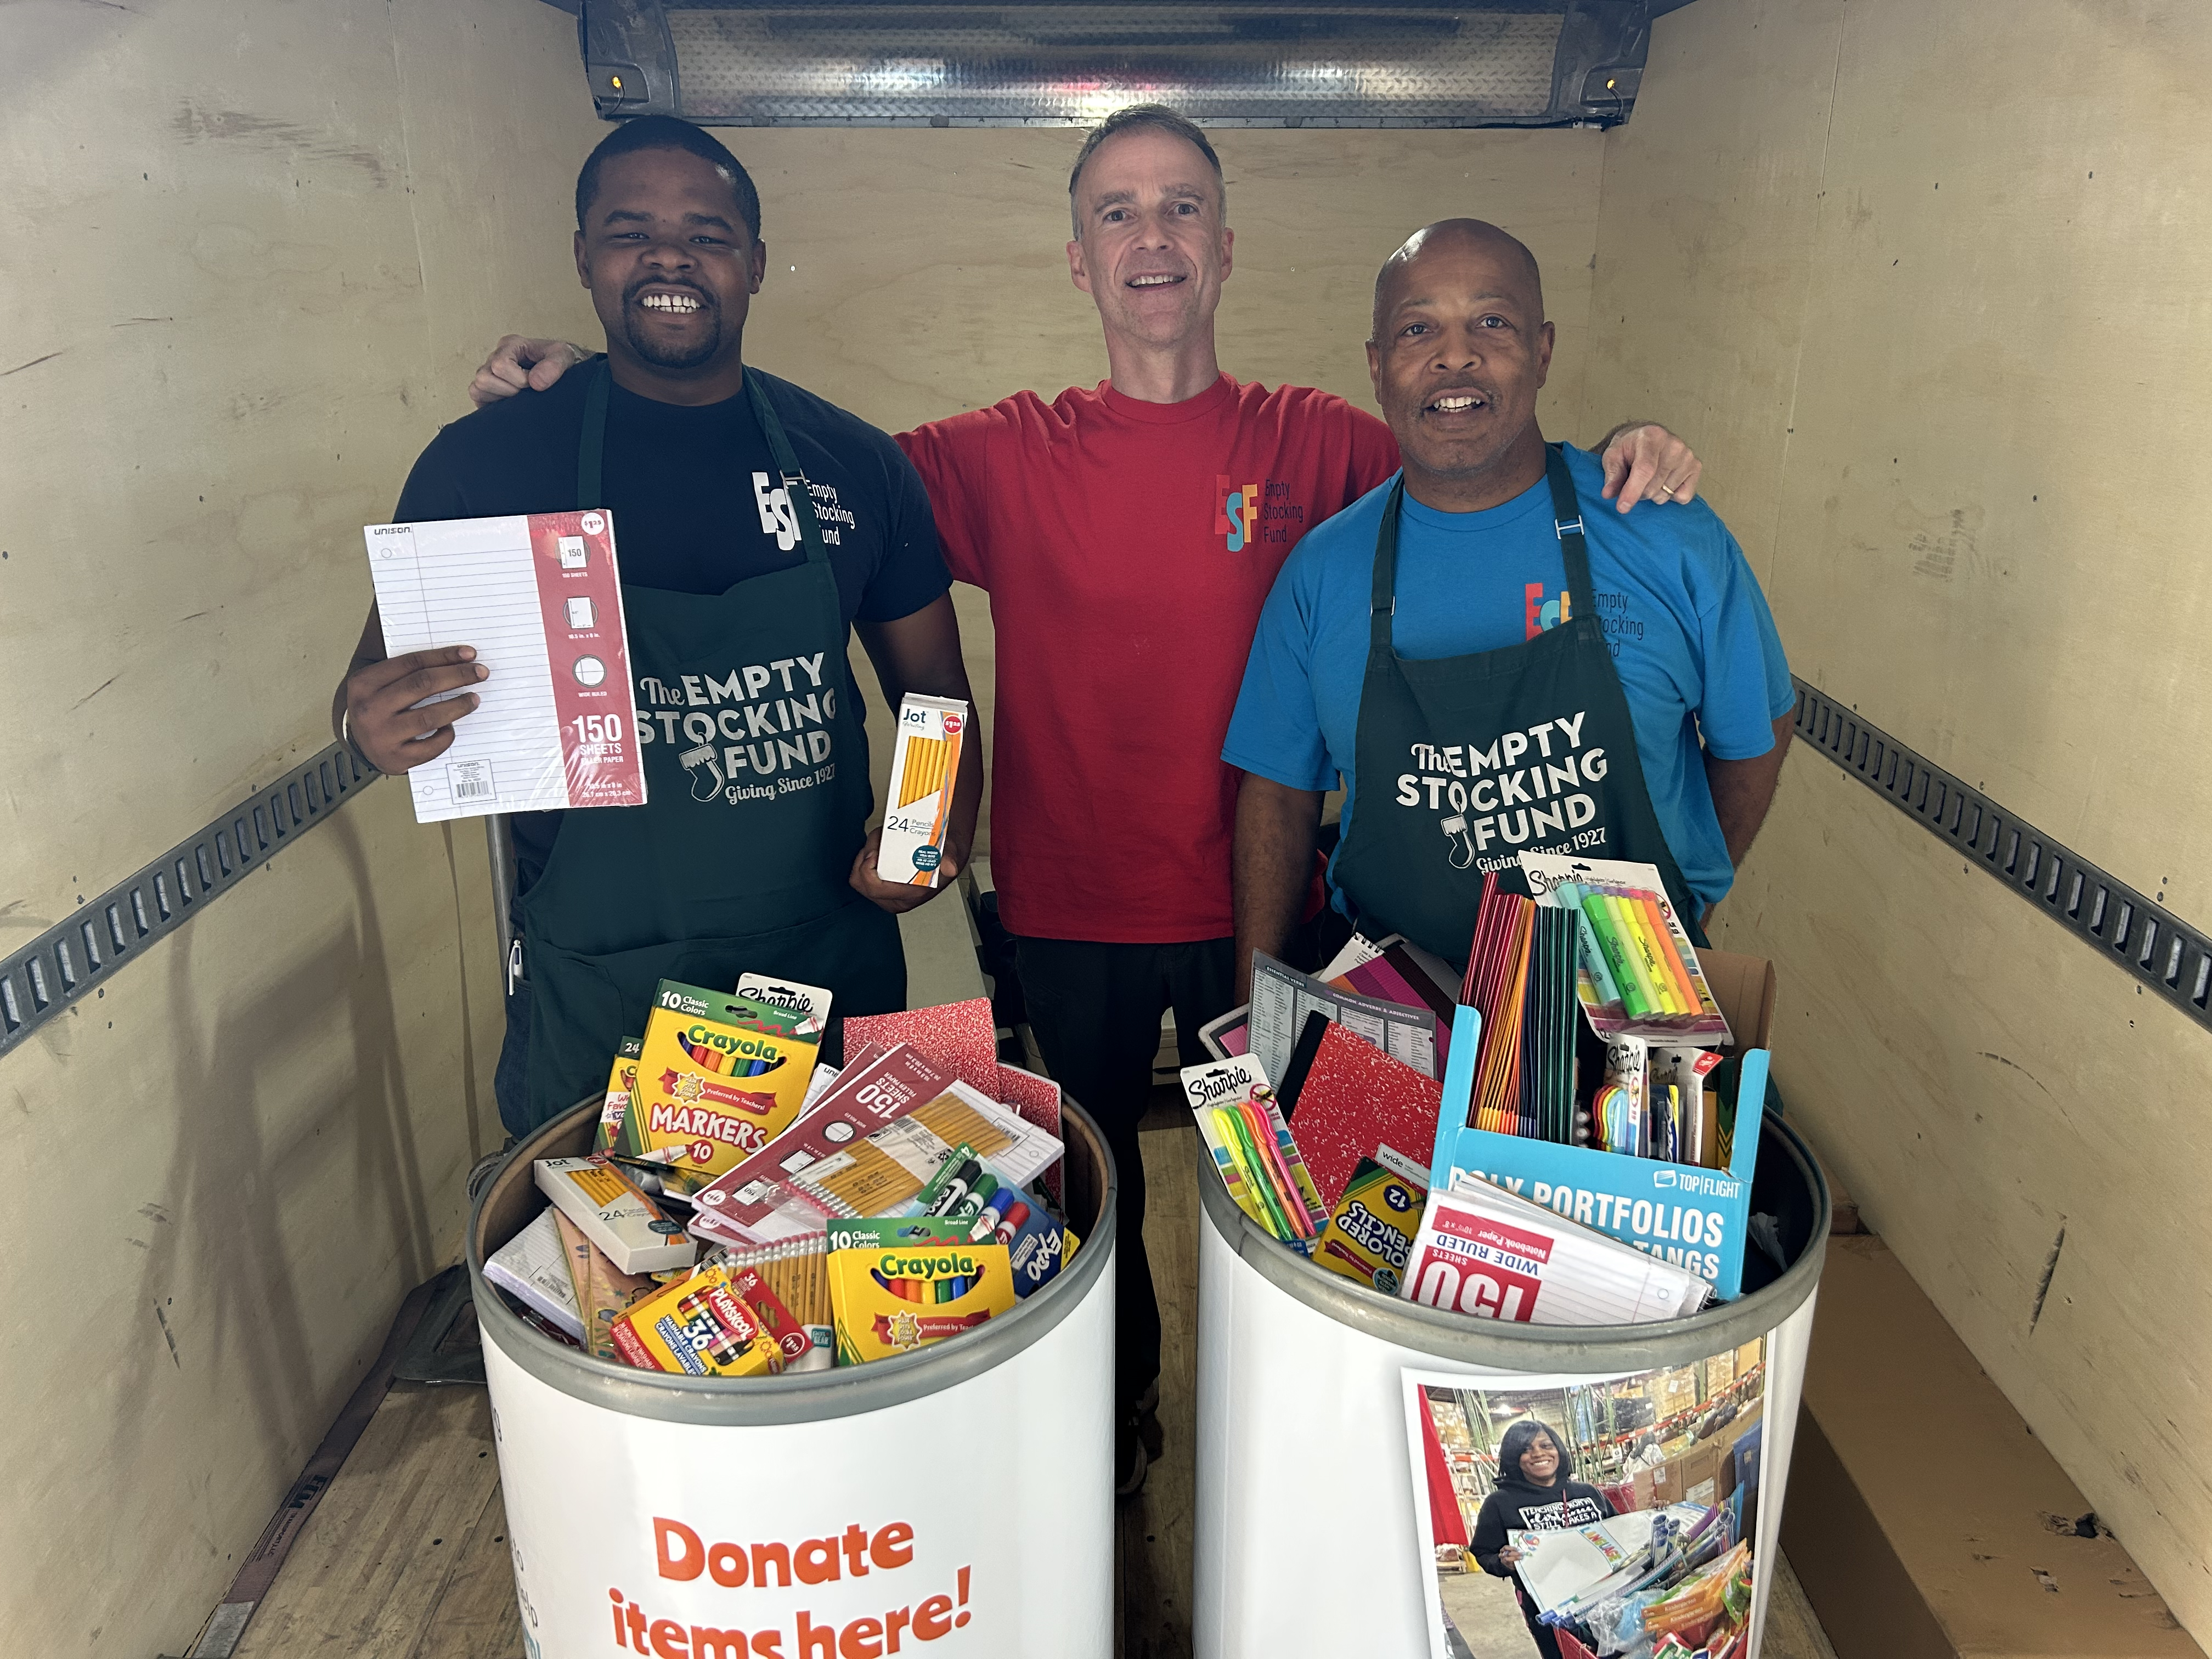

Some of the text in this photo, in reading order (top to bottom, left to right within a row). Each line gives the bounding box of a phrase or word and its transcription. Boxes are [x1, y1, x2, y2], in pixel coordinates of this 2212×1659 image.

[1265, 479, 1290, 500] Empty
[1214, 474, 1258, 552] ESF
[1263, 502, 1303, 523] Stocking
[819, 524, 840, 545] und
[1263, 526, 1287, 543] Fund
[568, 548, 582, 557] 150
[1599, 615, 1644, 641] ocking
[640, 652, 825, 707] The EMPTY
[572, 714, 623, 743] 150
[636, 687, 836, 744] STOCKING
[903, 708, 927, 724] Jot
[580, 742, 622, 755] SHEETS
[724, 730, 832, 779] FUND
[1442, 711, 1585, 778] EMPTY
[725, 763, 836, 805] Giving Since 1927
[1396, 747, 1607, 812] STOCKING
[887, 816, 909, 832] 24
[1473, 793, 1596, 851] FUND
[1571, 827, 1607, 850] 1927
[1579, 926, 1592, 954] Sharpie
[1606, 935, 1624, 966] Sharpie
[1638, 936, 1656, 966] Sharpie
[1266, 966, 1305, 988] ESSENTIAL VERBS
[661, 990, 709, 1009] 10 Classic
[680, 1004, 707, 1016] Colors
[738, 988, 814, 1013] Sharpie
[1333, 992, 1357, 1005] COMMON
[1358, 1002, 1381, 1012] ADVERBS
[1389, 1009, 1420, 1020] ADJECTIVES
[773, 1009, 787, 1018] Broad
[624, 1042, 640, 1053] 24
[688, 1024, 778, 1061] Crayola
[1607, 1044, 1640, 1073] Sharpie
[823, 1066, 839, 1078] uni
[883, 1071, 917, 1097] FILLER PAPER
[706, 1088, 733, 1100] Preferred
[740, 1097, 765, 1111] Teachers!
[876, 1077, 910, 1104] SHEETS
[1189, 1066, 1251, 1109] Sharpie
[855, 1084, 901, 1119] 150
[651, 1104, 766, 1153] MARKERS
[545, 1159, 571, 1167] Jot
[693, 1142, 712, 1159] 10
[961, 1146, 970, 1156] 4
[1383, 1152, 1403, 1168] wide
[956, 1200, 974, 1217] EX
[1389, 1188, 1406, 1208] 12
[599, 1209, 625, 1221] 24
[1533, 1181, 1724, 1248] PORTFOLIOS
[830, 1230, 881, 1250] 10 Classic
[1347, 1201, 1411, 1255] PENCILS
[853, 1240, 880, 1249] Colors
[1026, 1227, 1062, 1282] EXPO
[1338, 1215, 1405, 1268] OLORED
[1477, 1229, 1546, 1259] Notebook Paper
[881, 1252, 974, 1279] Crayola
[1432, 1249, 1468, 1266] SHEETS
[1436, 1234, 1538, 1276] WIDE RULED
[1633, 1240, 1719, 1279] TANGS
[744, 1272, 759, 1287] 36
[1418, 1261, 1524, 1322] 150
[709, 1287, 754, 1341] PLAYSKOOL
[664, 1314, 708, 1372] WASHABLE CRAYONS
[682, 1318, 714, 1351] 36
[814, 1335, 830, 1344] GEAR
[656, 1322, 697, 1376] CRAYONS LAVABLES
[1523, 1502, 1564, 1516] TEACHING
[1533, 1520, 1560, 1530] STILL
[652, 1516, 915, 1588] Donate
[1579, 1526, 1622, 1562] LANGUAGE
[608, 1587, 787, 1659] items
[795, 1564, 972, 1659] here!
[1664, 1598, 1697, 1612] Kindergarten
[1670, 1607, 1703, 1623] Kindergarten
